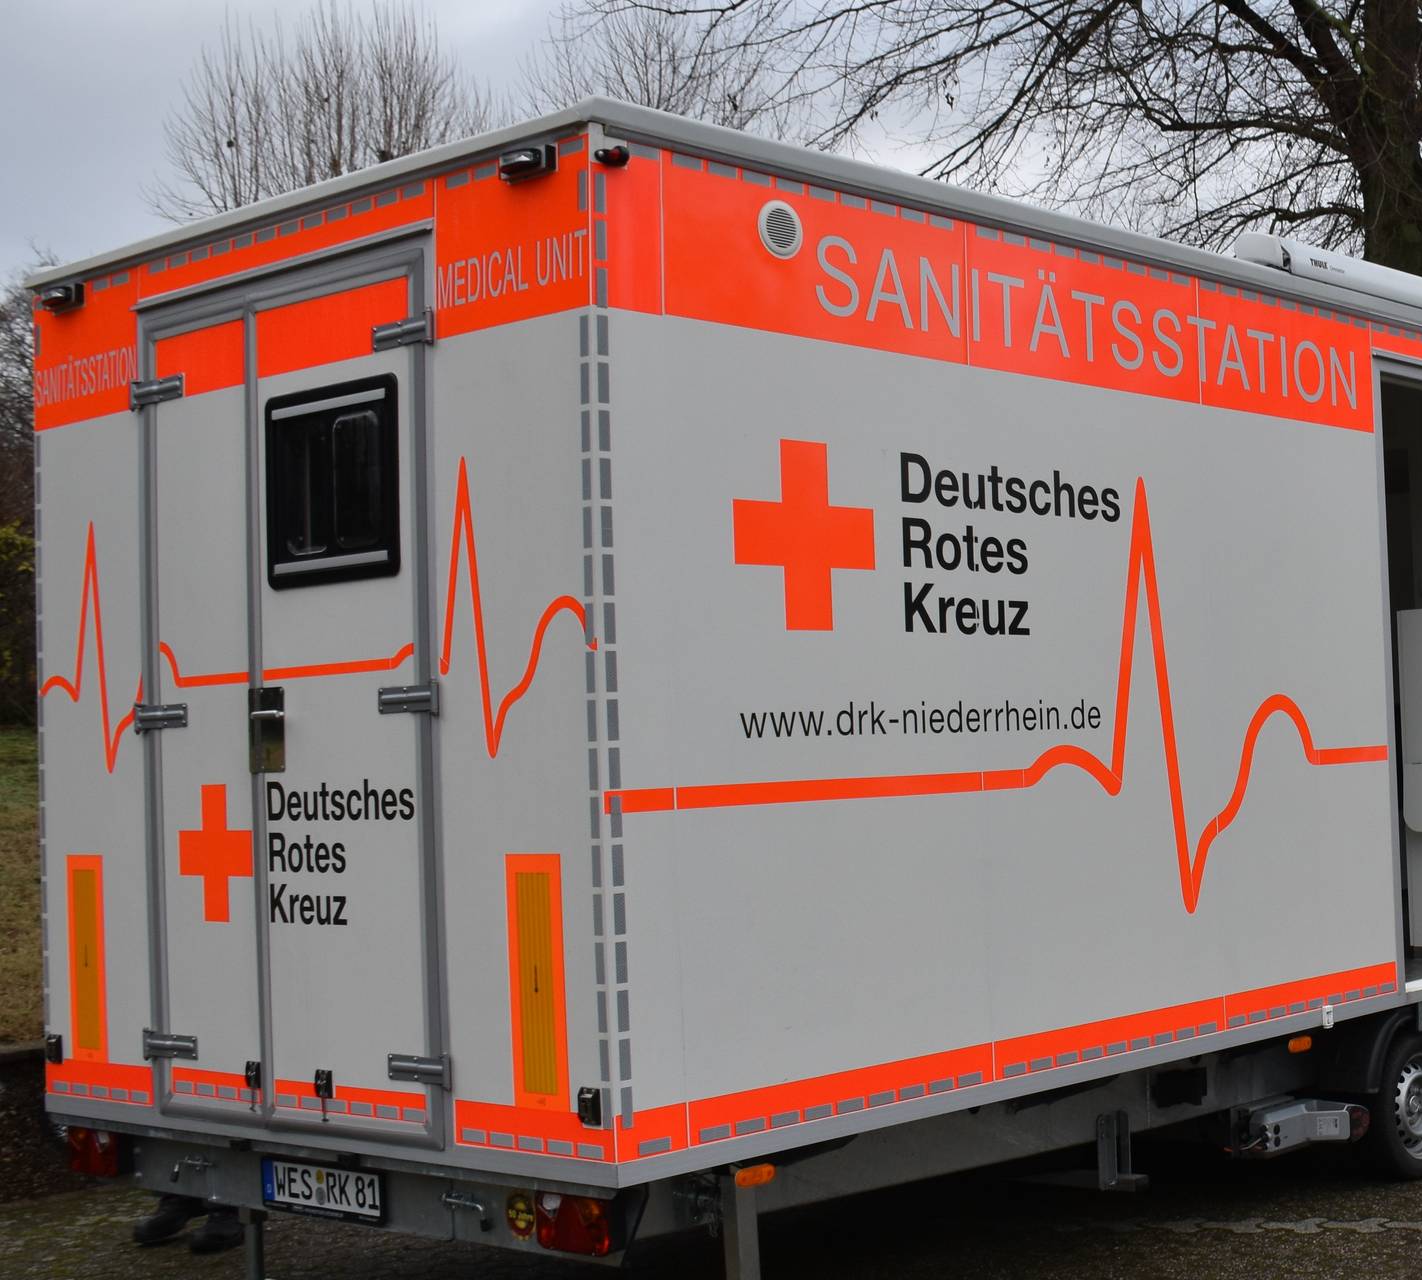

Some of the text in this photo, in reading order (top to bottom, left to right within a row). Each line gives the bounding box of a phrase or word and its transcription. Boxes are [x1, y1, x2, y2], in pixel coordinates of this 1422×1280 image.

[438, 229, 588, 309] MEDICAL UNIT
[815, 236, 1357, 410] SANITÄTSSTATION
[900, 452, 1121, 522] Deutsches
[902, 517, 1028, 575] Rotes
[904, 582, 1031, 636] Kreuz
[740, 699, 1101, 738] www.drk-niederrhein.de
[266, 779, 415, 821] Deutsches
[268, 832, 347, 873] Rotes
[269, 883, 348, 926] Kreuz
[275, 1165, 313, 1200] WES
[326, 1171, 351, 1206] RK
[355, 1175, 379, 1210] 81
